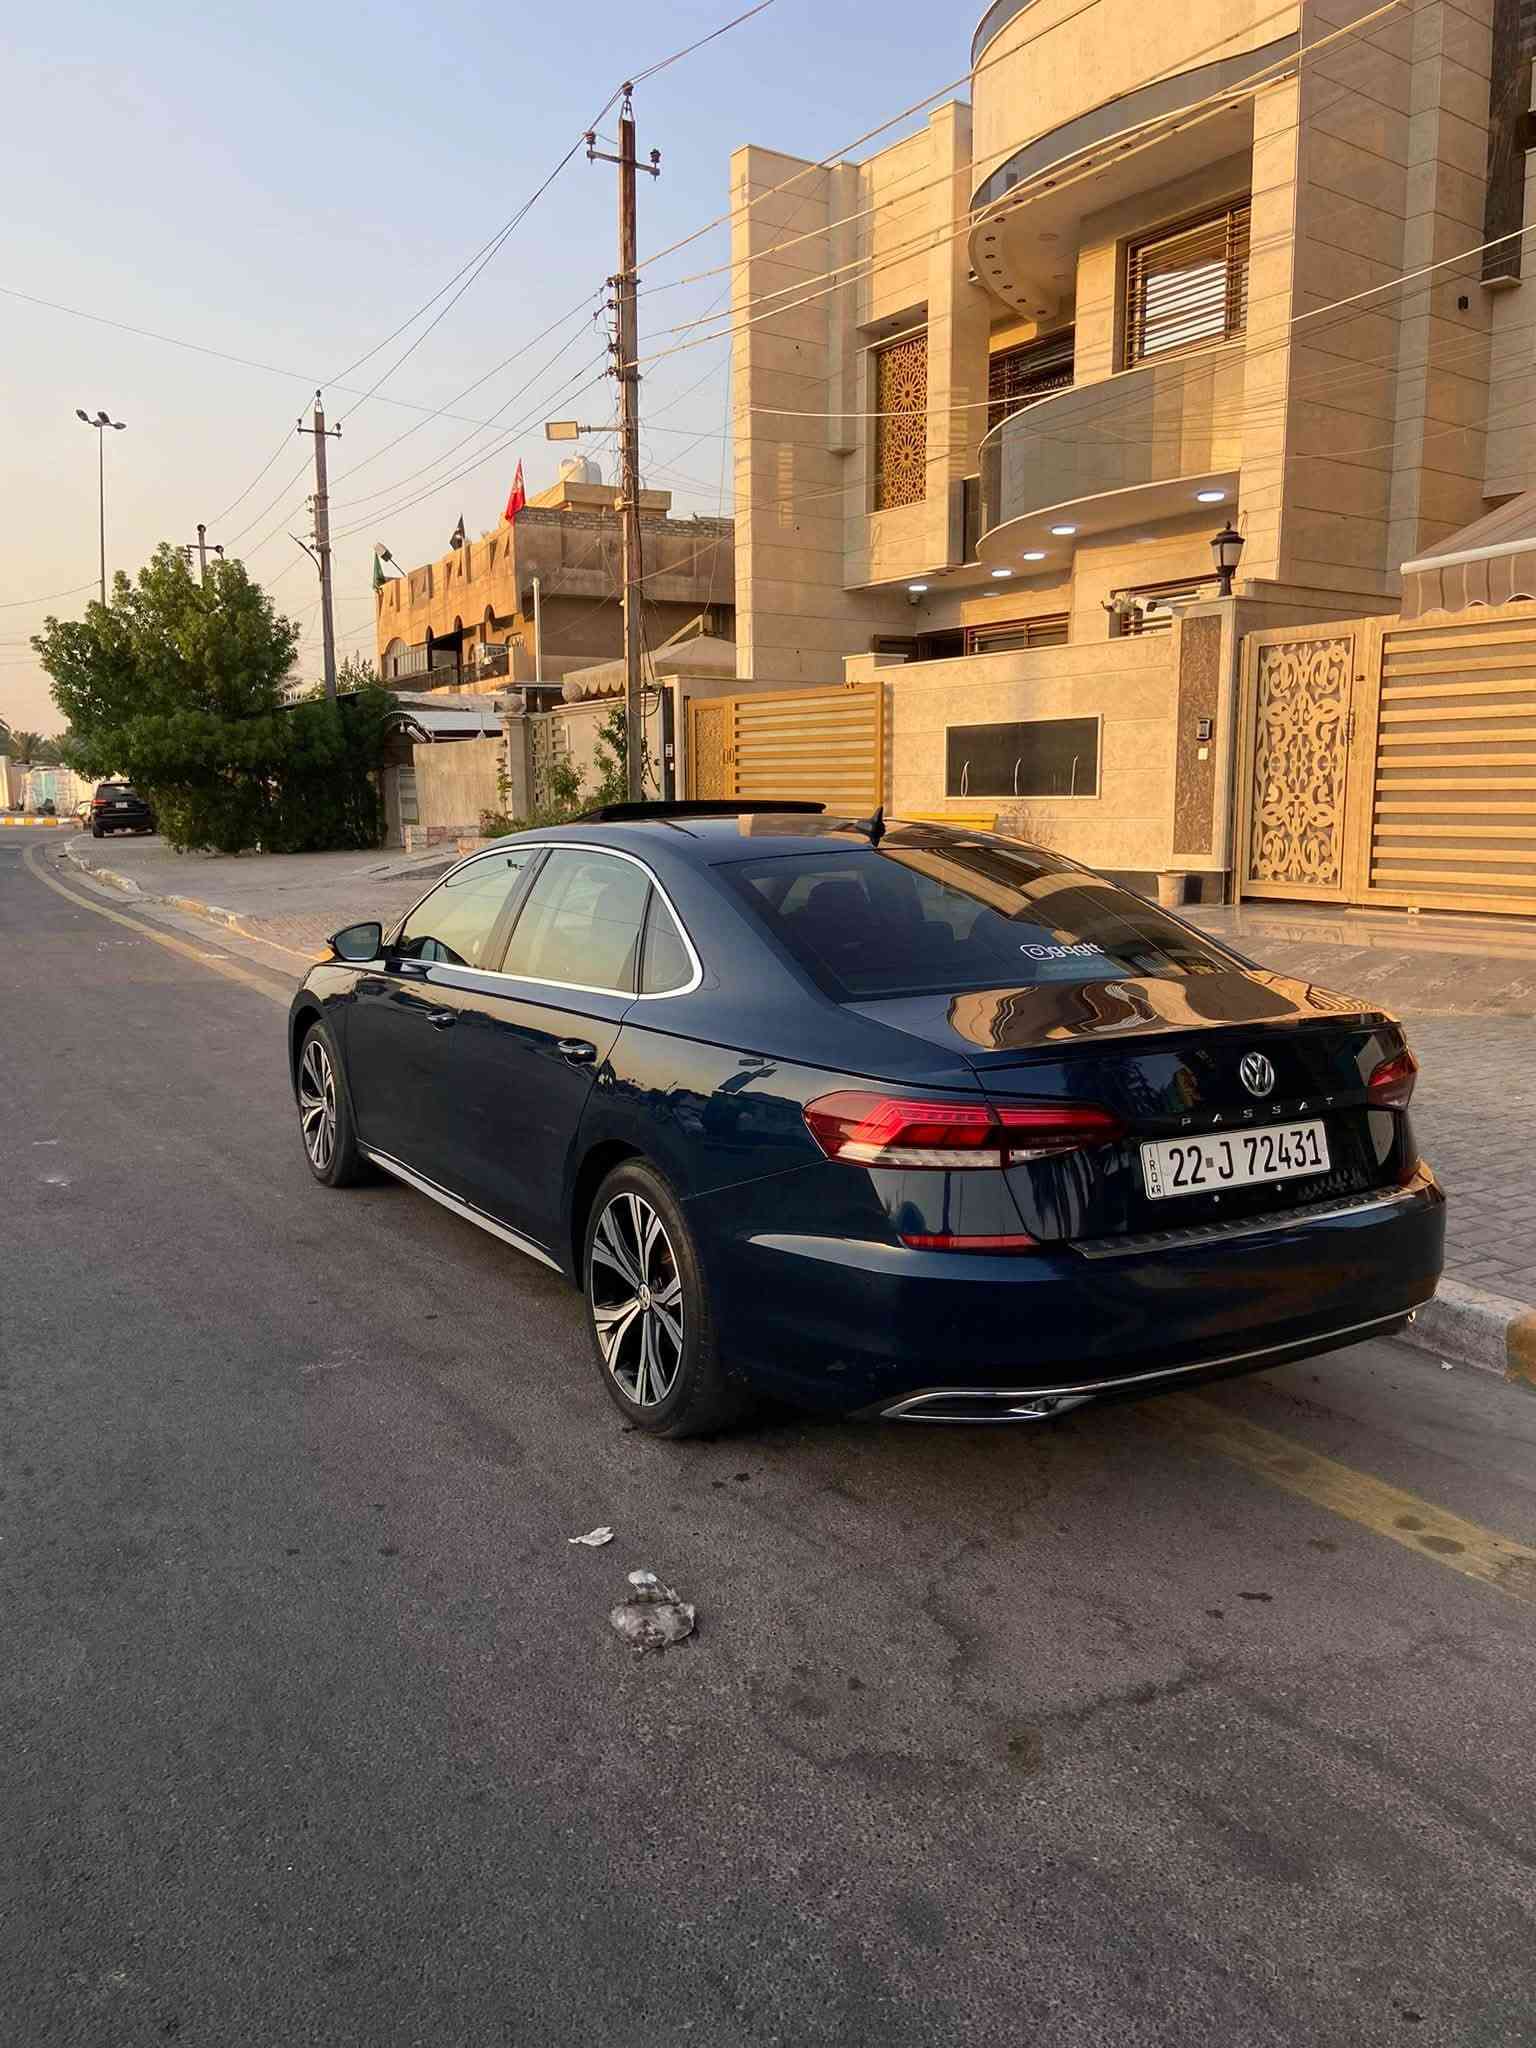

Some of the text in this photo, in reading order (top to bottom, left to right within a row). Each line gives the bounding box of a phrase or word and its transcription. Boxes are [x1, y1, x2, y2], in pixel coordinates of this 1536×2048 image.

[1181, 1096, 1334, 1127] PASSAT
[1169, 1128, 1322, 1187] 22 J 72431
